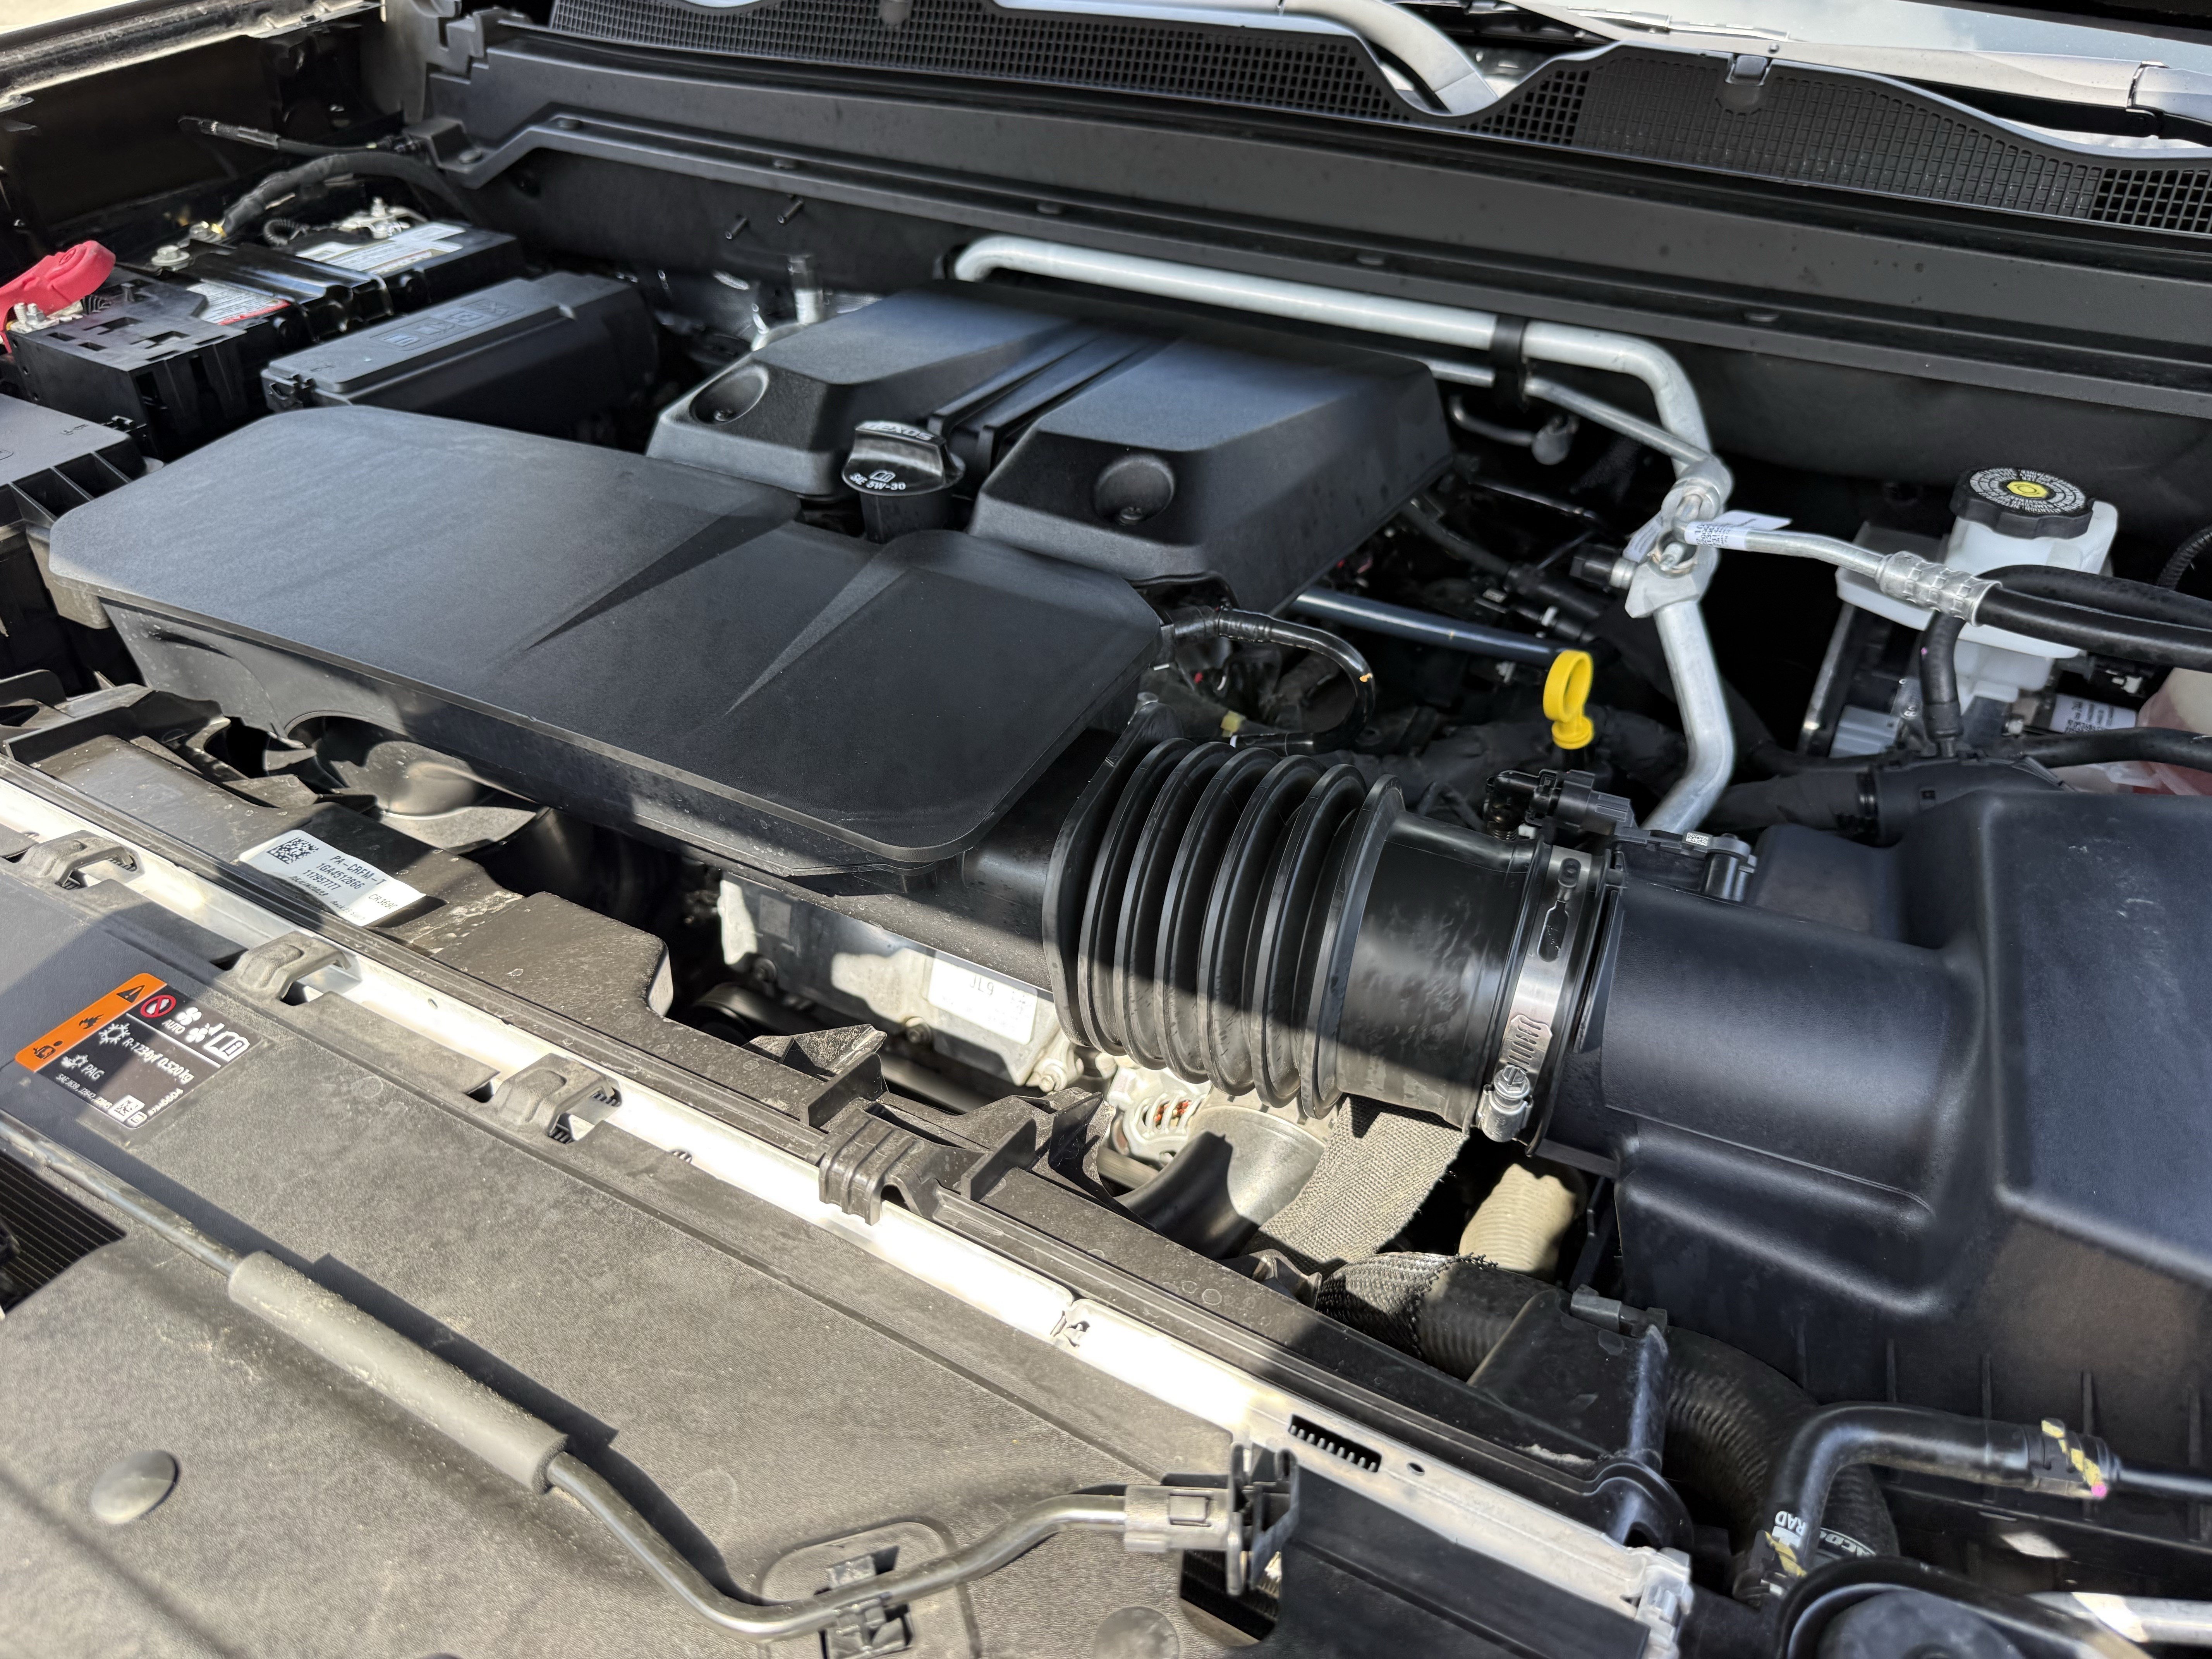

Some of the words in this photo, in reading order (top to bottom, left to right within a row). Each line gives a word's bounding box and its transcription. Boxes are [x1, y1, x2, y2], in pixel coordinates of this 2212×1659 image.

[849, 473, 868, 485] SAE
[866, 481, 906, 490] 5W-30
[969, 974, 994, 996] JL9
[161, 1019, 186, 1035] AUTO
[122, 1038, 163, 1063] R-1234yf
[179, 1069, 194, 1084] kg
[56, 1073, 70, 1084] SAE
[81, 1063, 105, 1080] PAG
[1775, 1510, 1807, 1536] RAD
